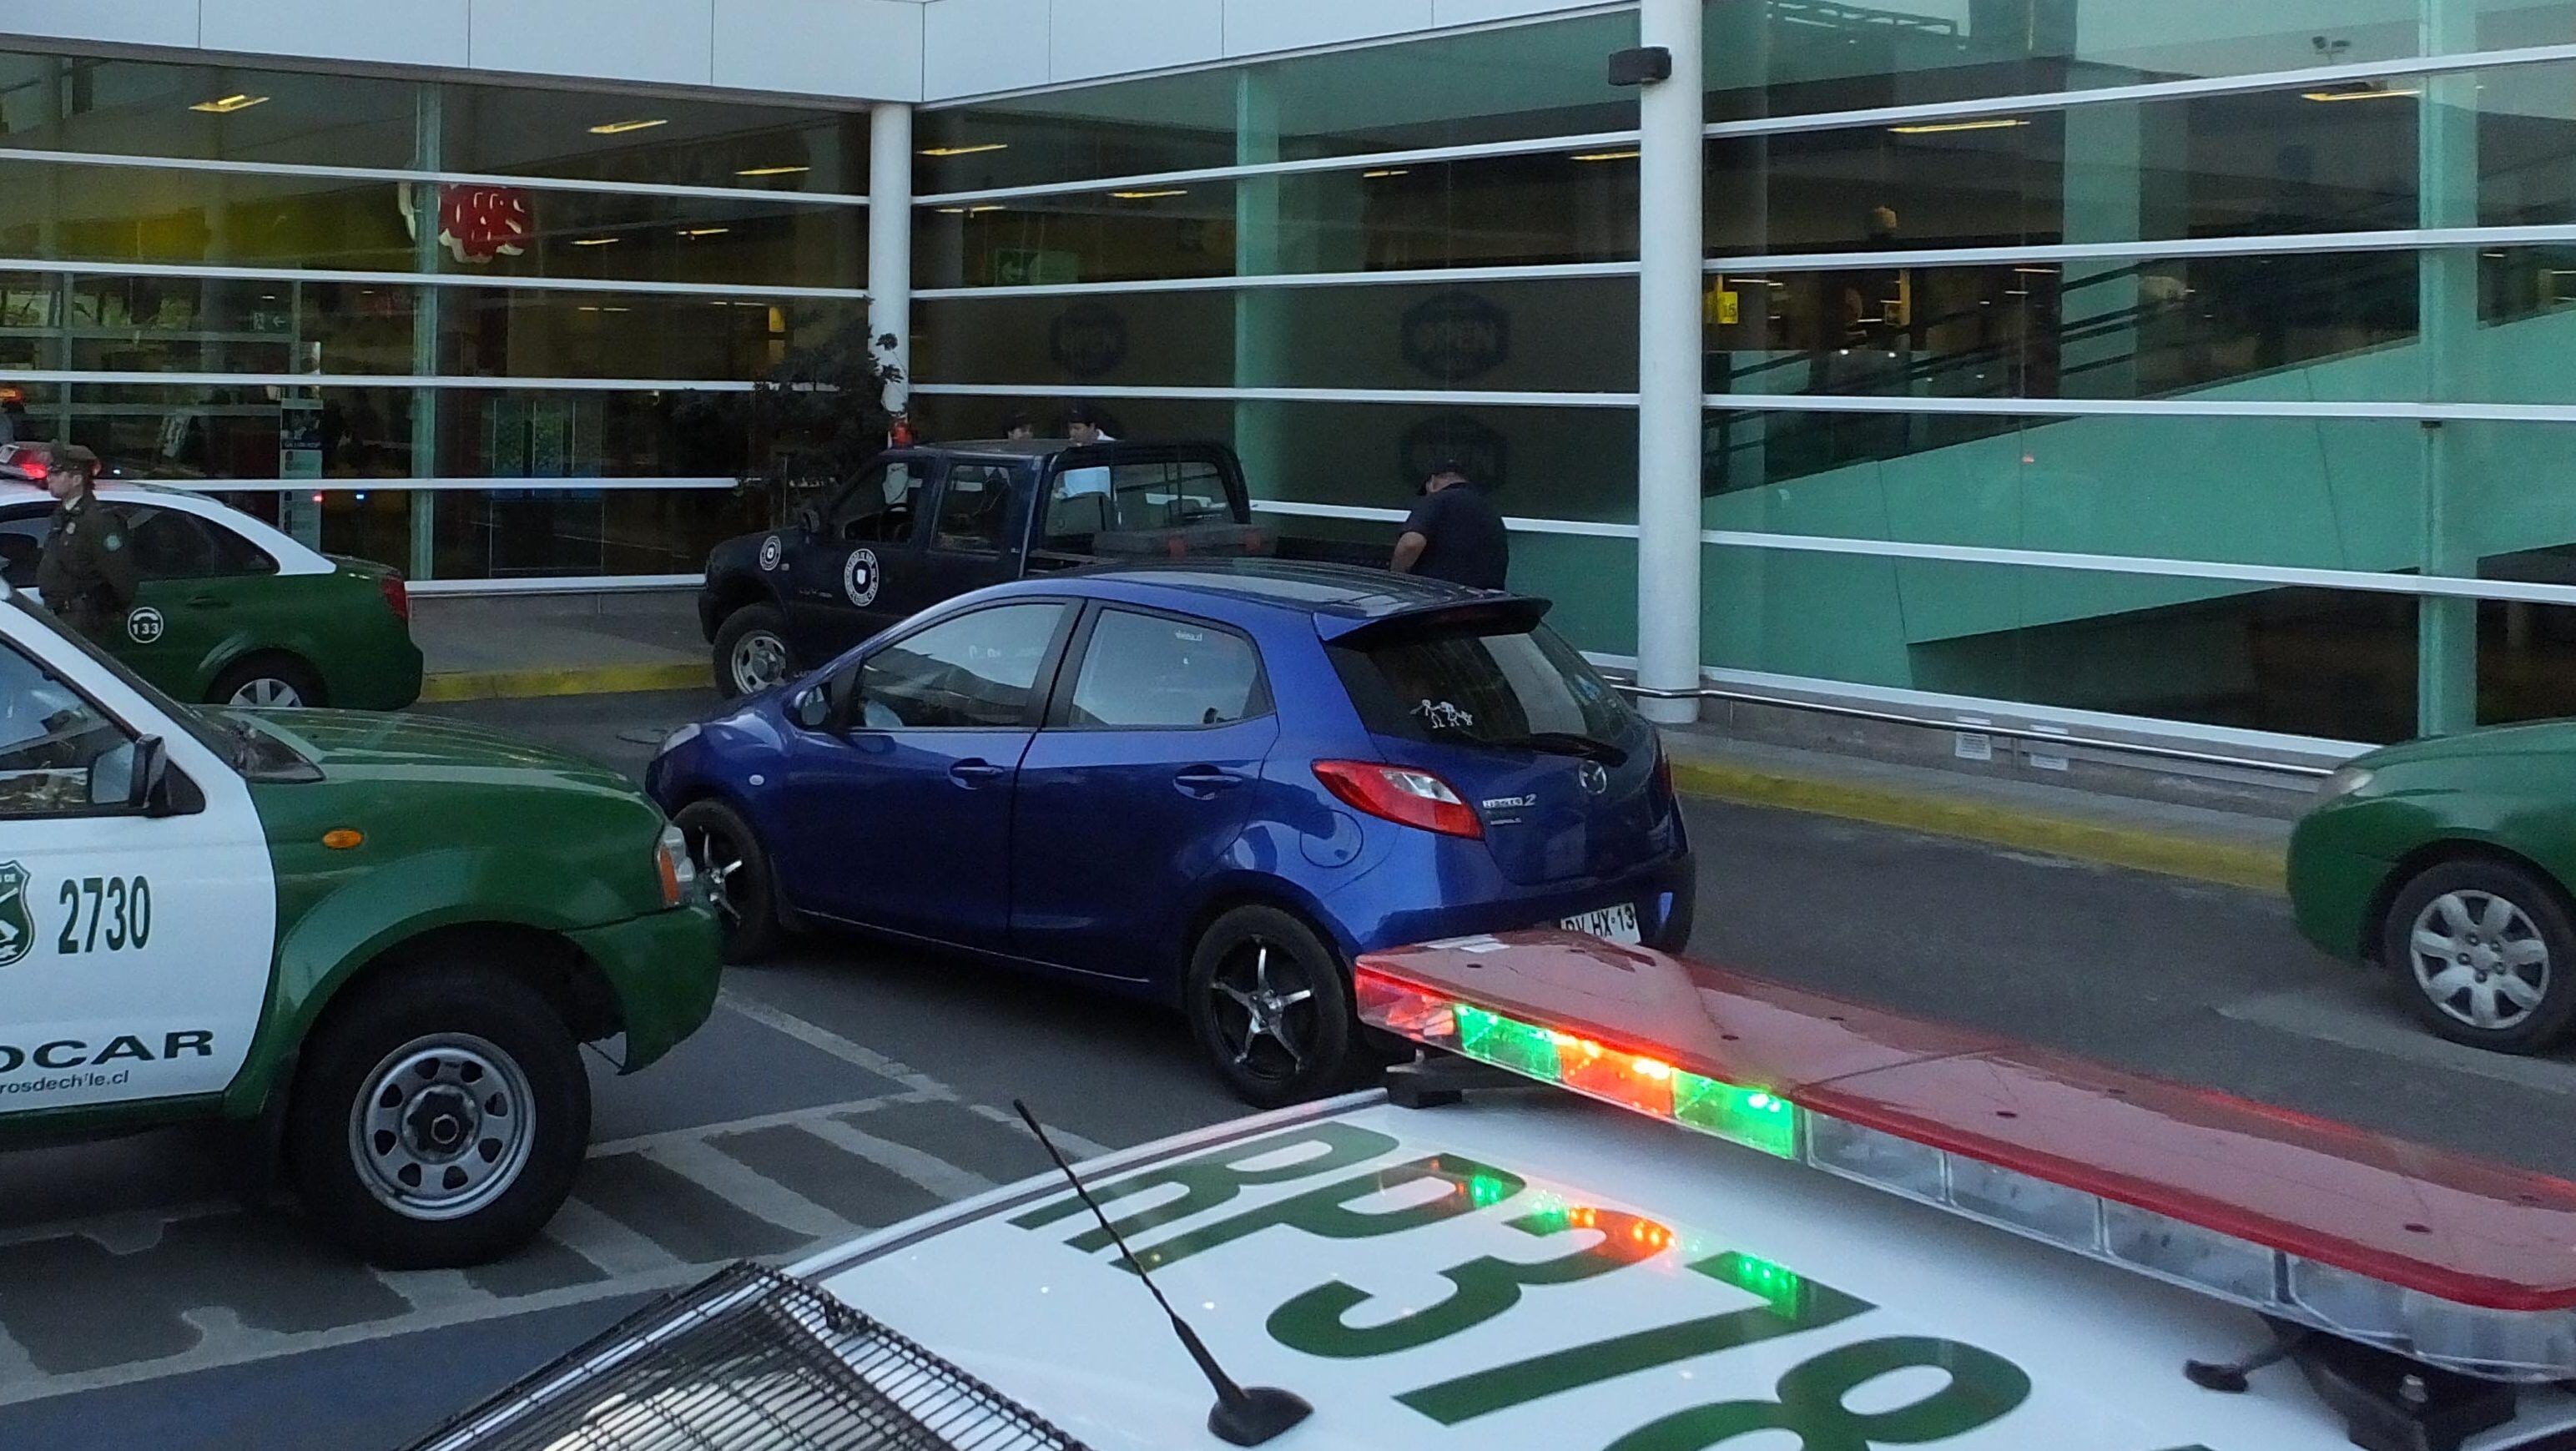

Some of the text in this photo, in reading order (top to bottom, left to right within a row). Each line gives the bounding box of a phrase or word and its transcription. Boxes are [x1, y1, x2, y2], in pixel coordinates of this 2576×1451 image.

[133, 622, 159, 635] 133
[58, 874, 151, 955] 2730
[1006, 1121, 2216, 1451] RP378
